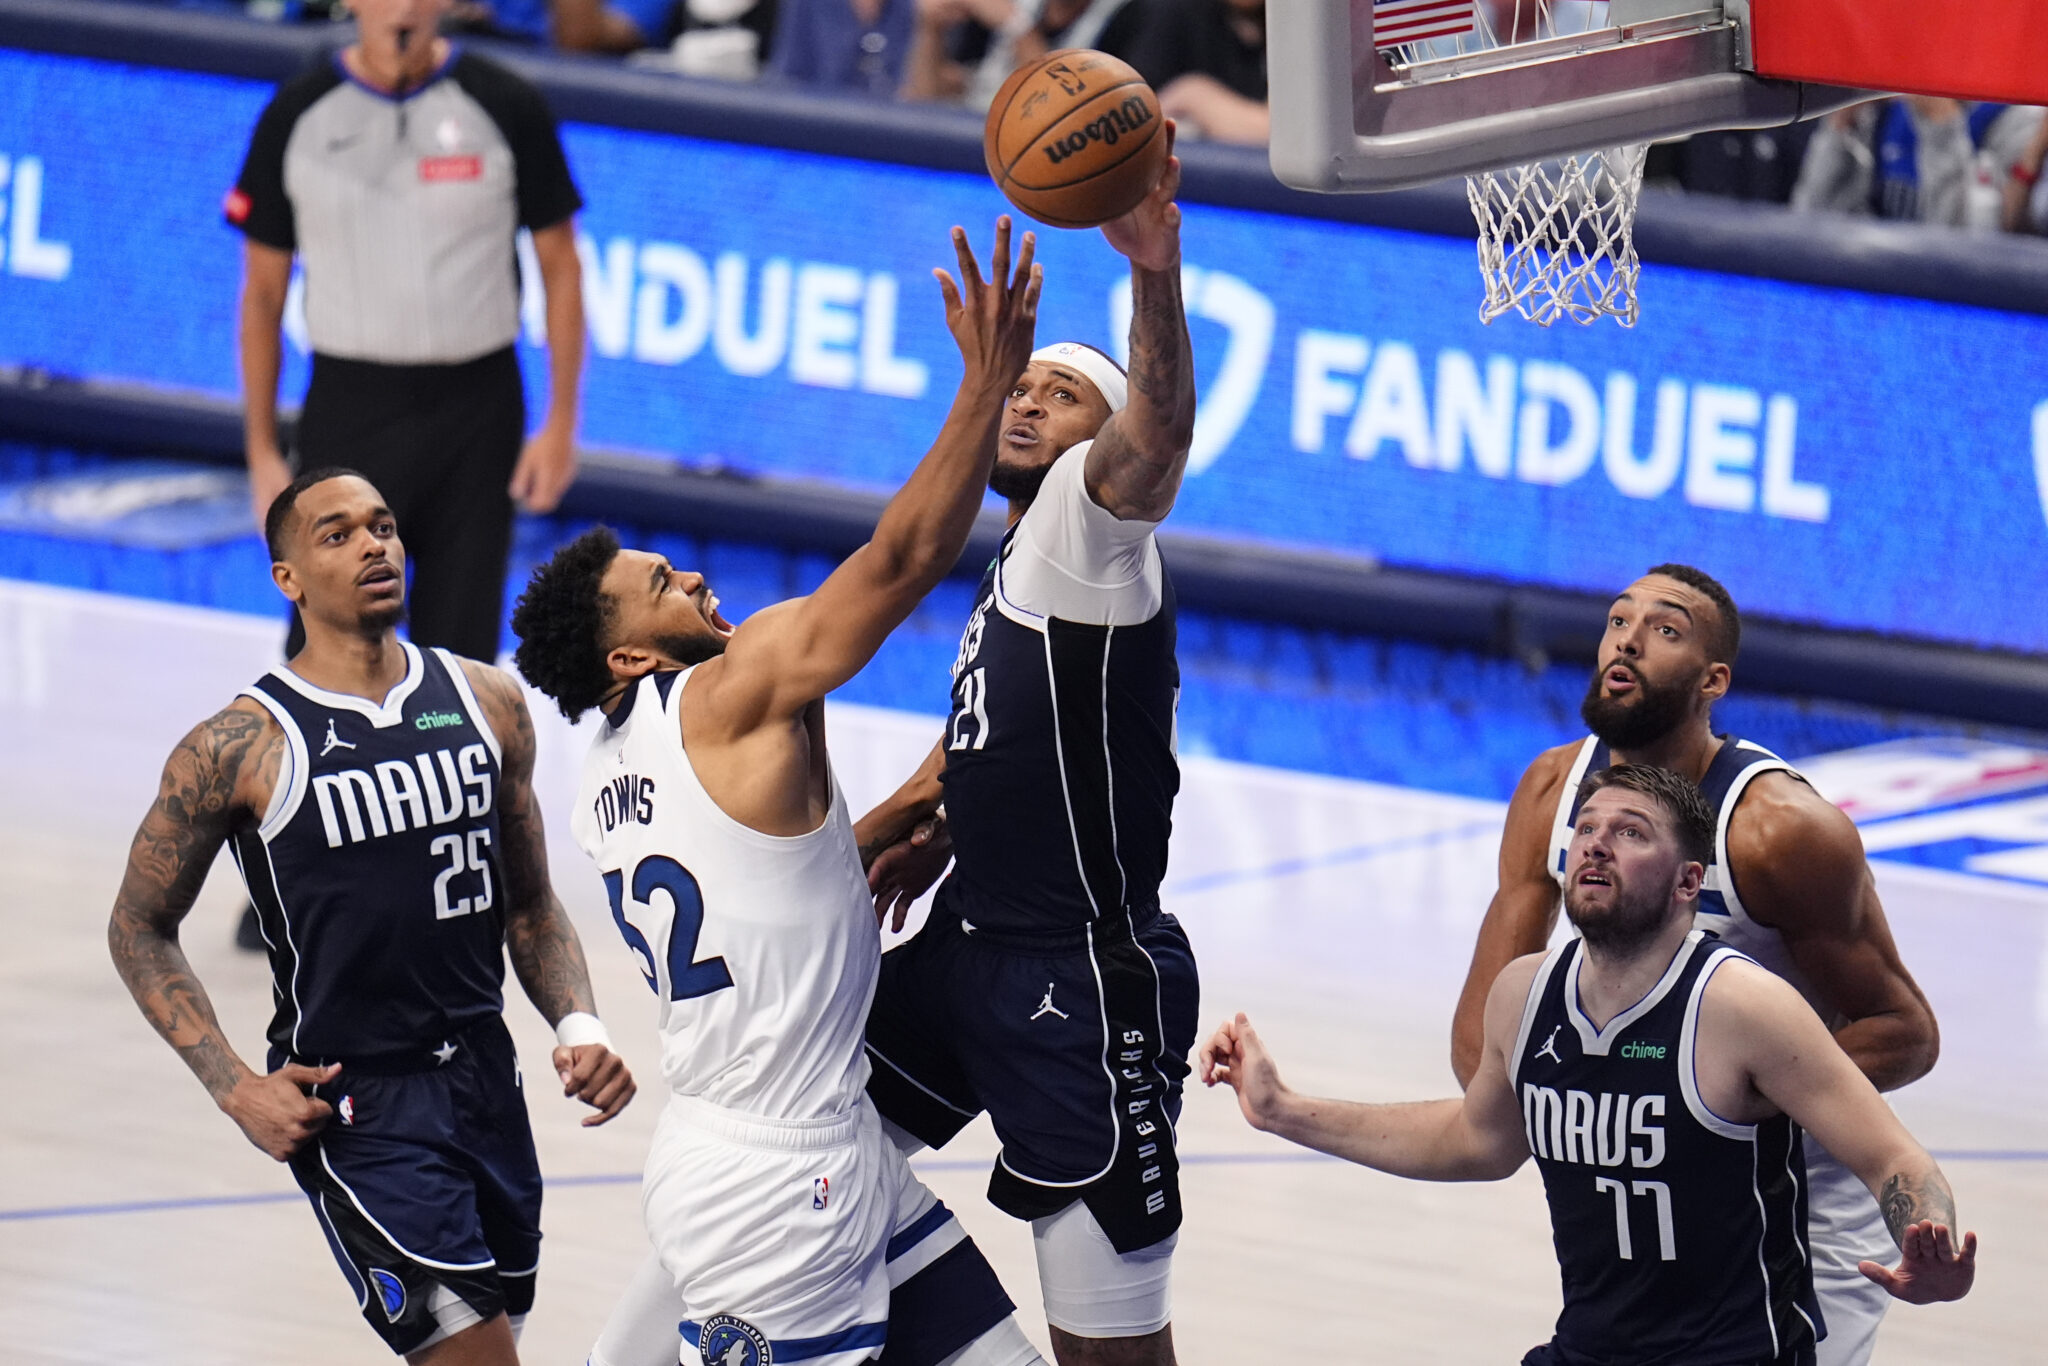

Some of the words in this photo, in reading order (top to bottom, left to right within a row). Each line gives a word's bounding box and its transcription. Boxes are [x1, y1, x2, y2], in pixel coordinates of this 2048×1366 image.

[1043, 96, 1153, 164] Wilson
[1291, 328, 1831, 523] FANDUEL
[415, 711, 464, 730] chime
[949, 666, 989, 750] 21
[594, 774, 655, 843] TOWNS
[430, 828, 492, 920] 25
[1621, 1041, 1667, 1059] chime
[1595, 1176, 1677, 1261] 77
[700, 1317, 730, 1356] MINNESOTA
